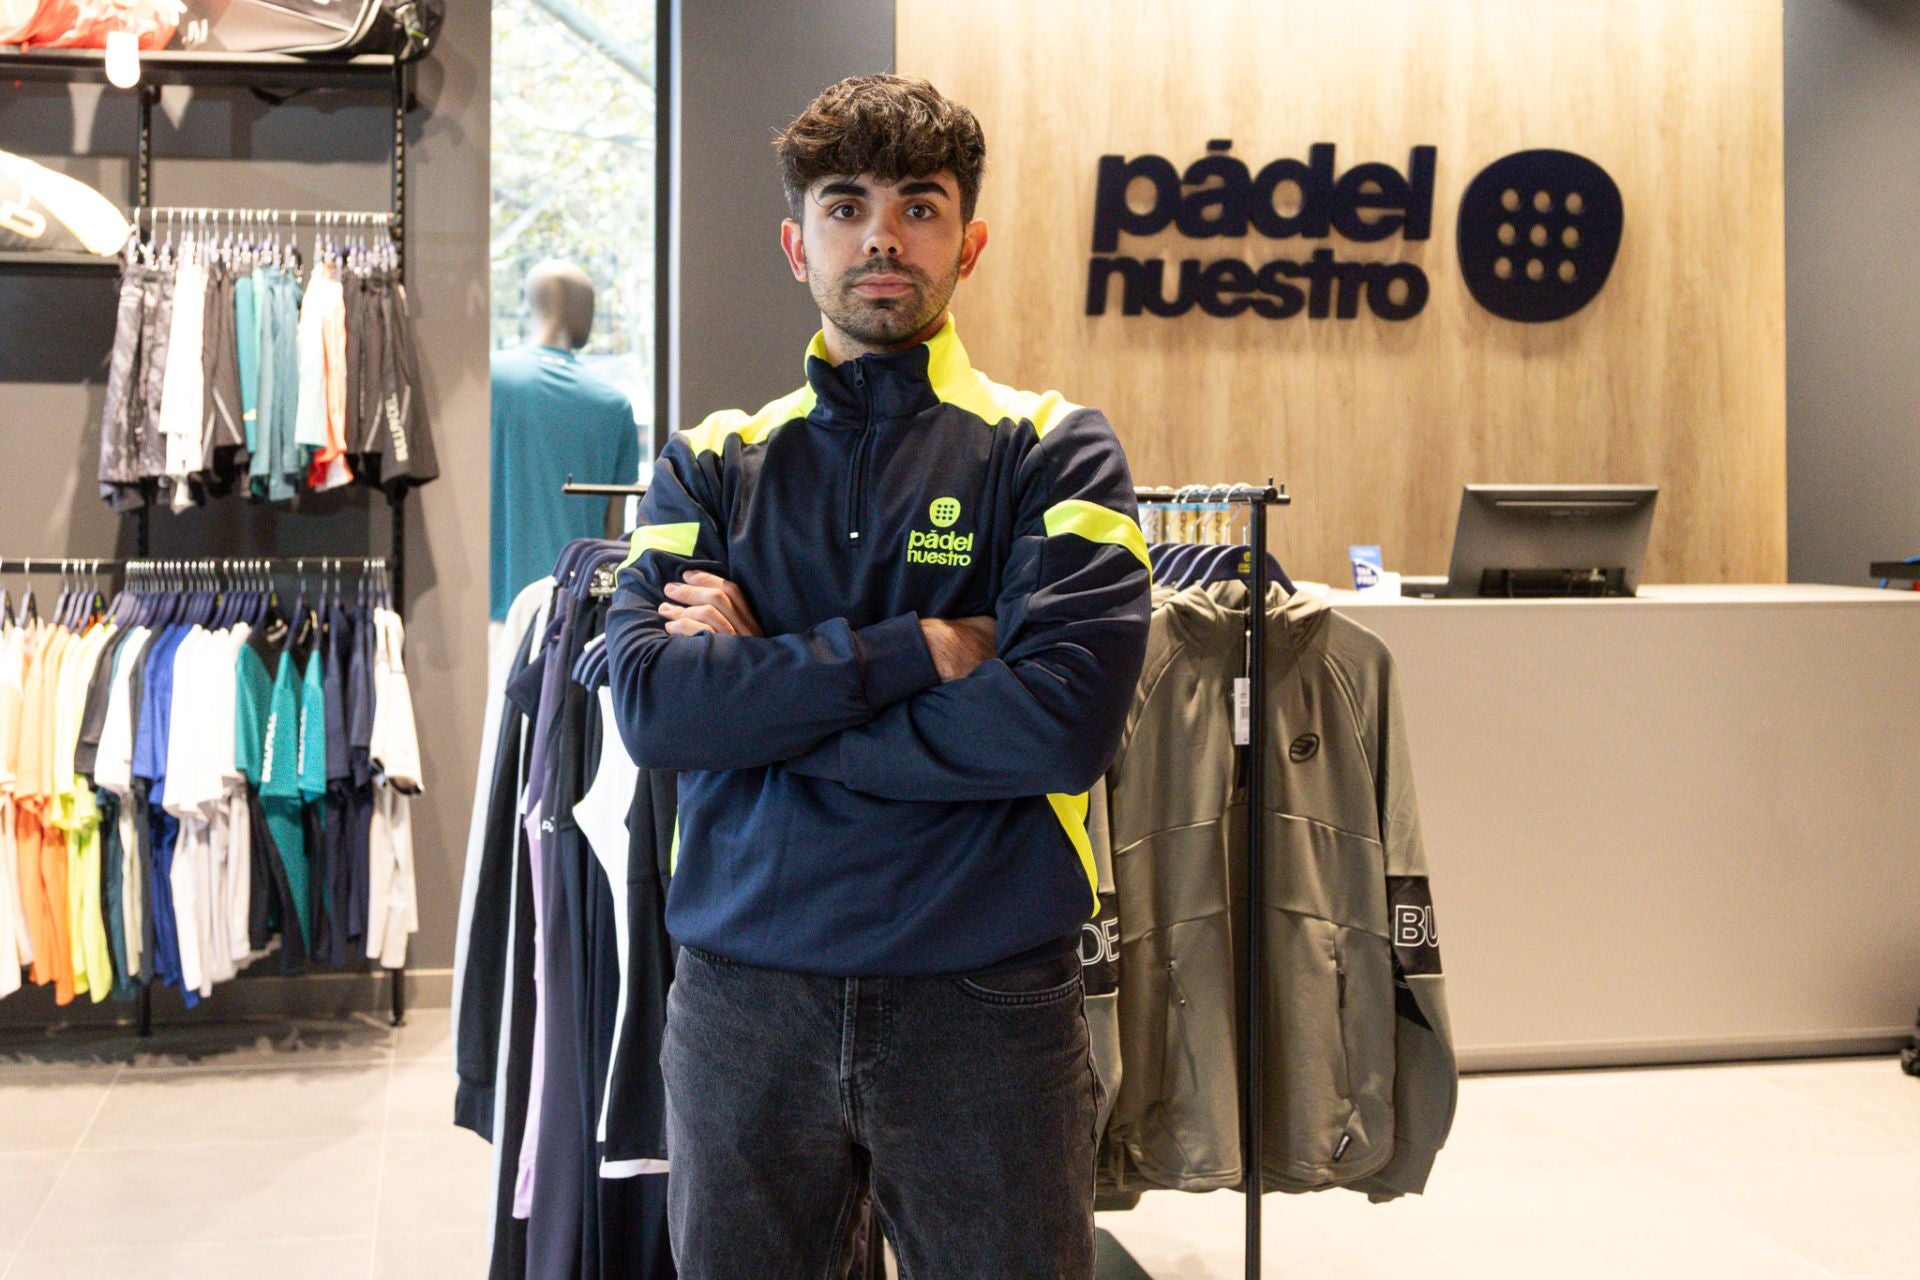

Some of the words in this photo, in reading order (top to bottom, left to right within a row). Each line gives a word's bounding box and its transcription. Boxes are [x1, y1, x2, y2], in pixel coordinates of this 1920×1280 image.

[1091, 139, 1437, 254] pádel
[1085, 247, 1430, 321] nuestro
[907, 549, 972, 566] nuestro
[908, 530, 974, 551] pádel
